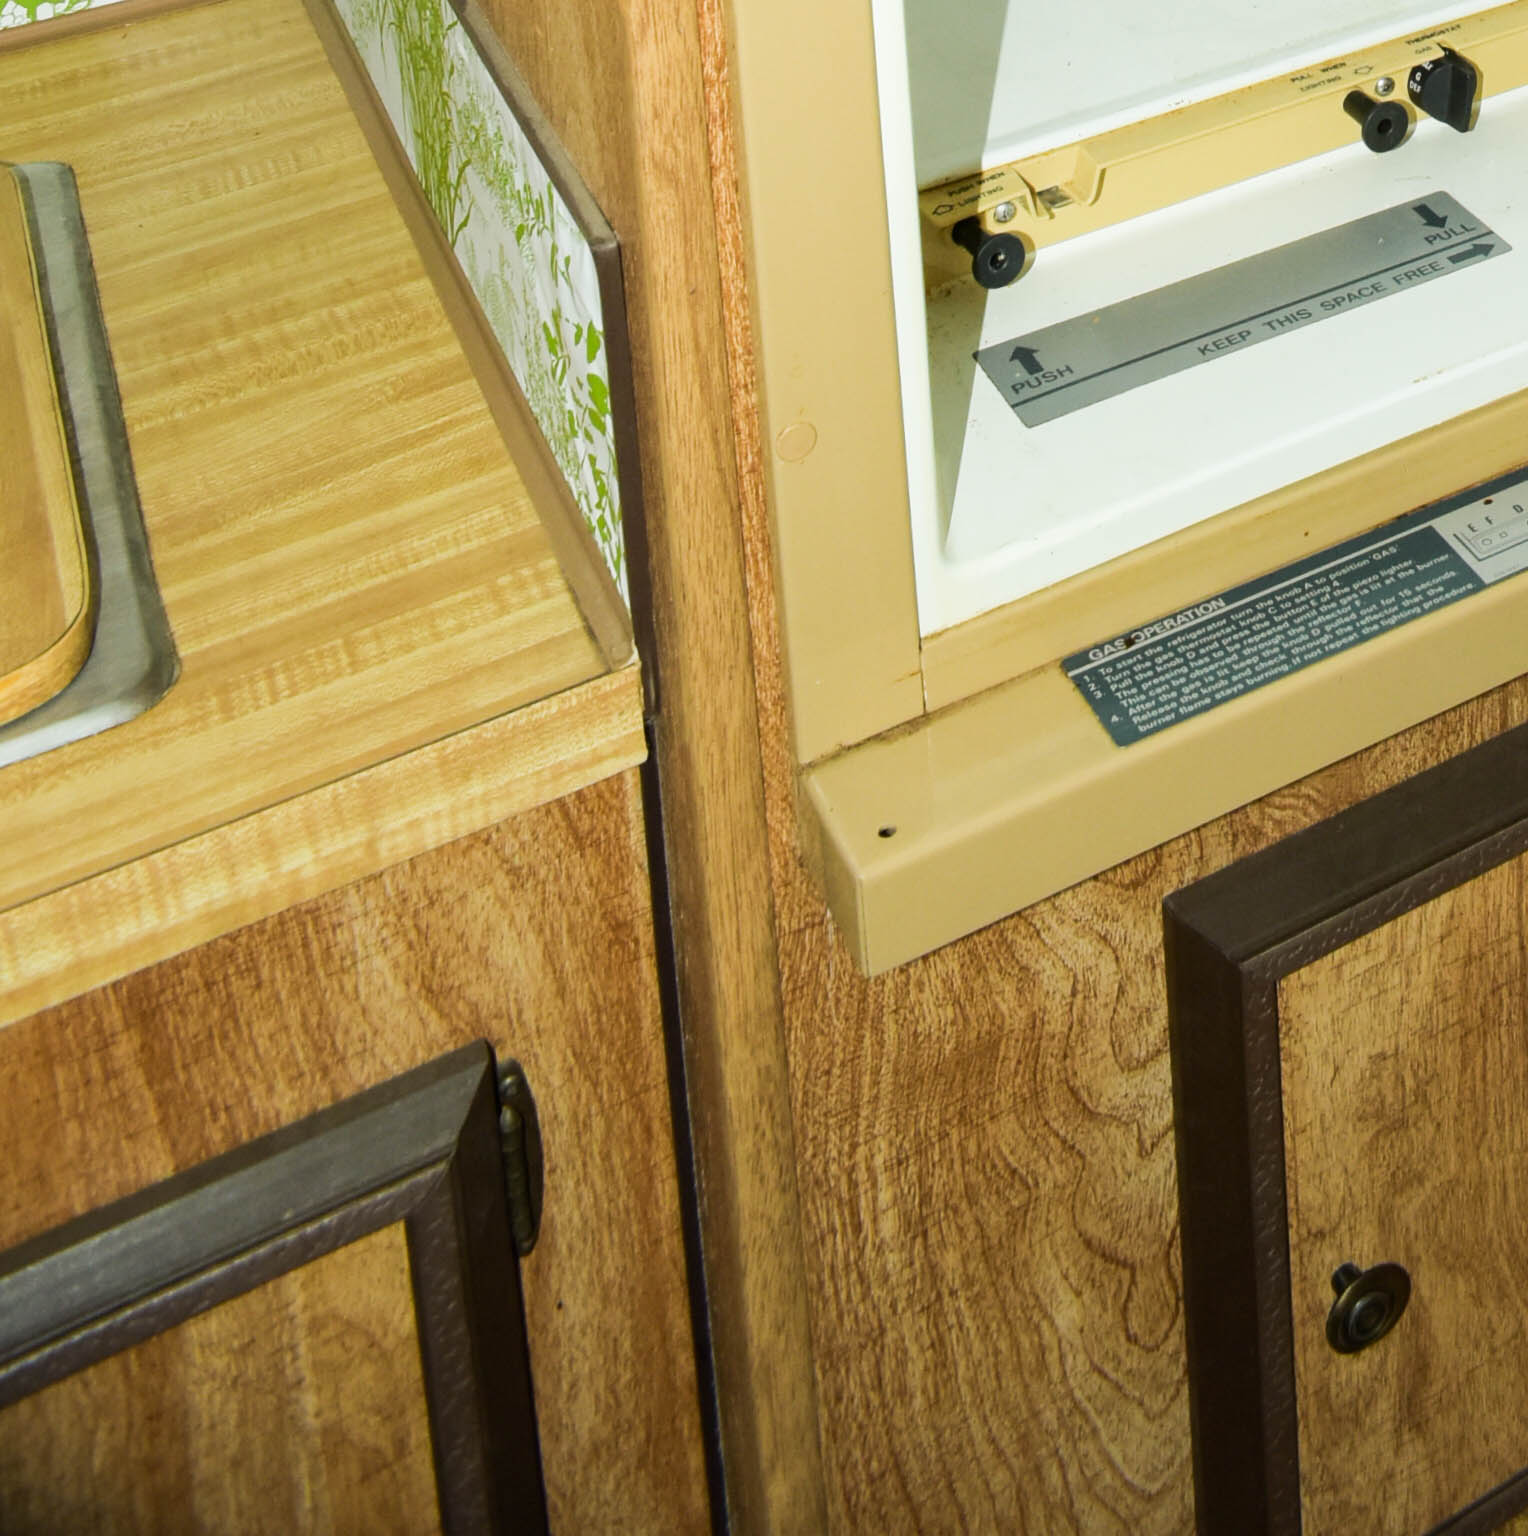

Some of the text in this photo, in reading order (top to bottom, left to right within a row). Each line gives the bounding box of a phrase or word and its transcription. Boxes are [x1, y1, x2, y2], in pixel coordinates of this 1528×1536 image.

[1320, 61, 1346, 73] WHEN
[1423, 223, 1477, 247] PULL
[1196, 260, 1445, 358] KEEP THIS SPACE FREE
[1011, 364, 1074, 396] PUSH
[1467, 523, 1478, 533] E
[1485, 516, 1494, 525] F
[1512, 504, 1524, 514] D
[1088, 597, 1226, 661] GAS OPERATION
